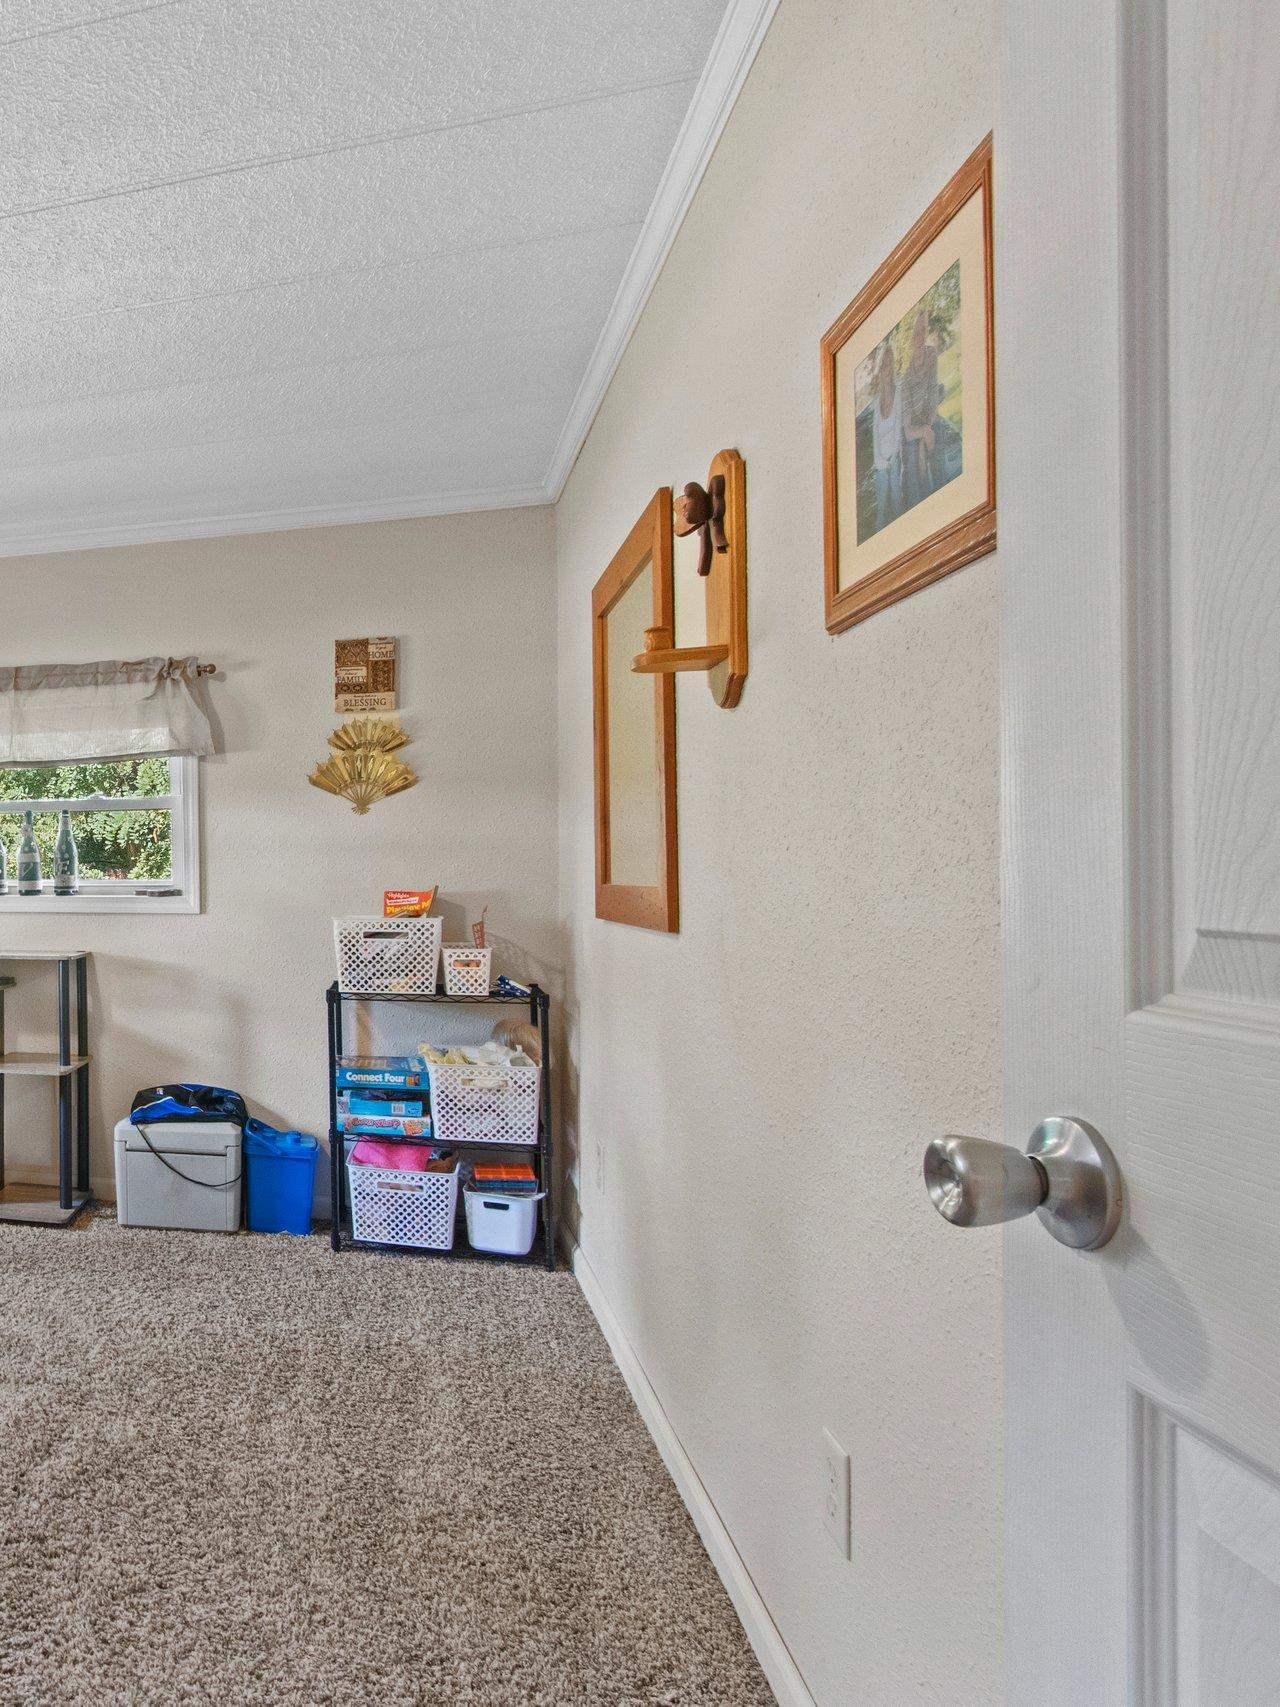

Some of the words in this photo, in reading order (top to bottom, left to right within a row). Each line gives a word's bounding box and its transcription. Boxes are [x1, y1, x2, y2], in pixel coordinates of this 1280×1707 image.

[336, 676, 367, 684] FAMILY
[343, 698, 387, 707] BLESSING
[345, 1071, 382, 1082] Connect
[384, 1072, 405, 1083] Four
